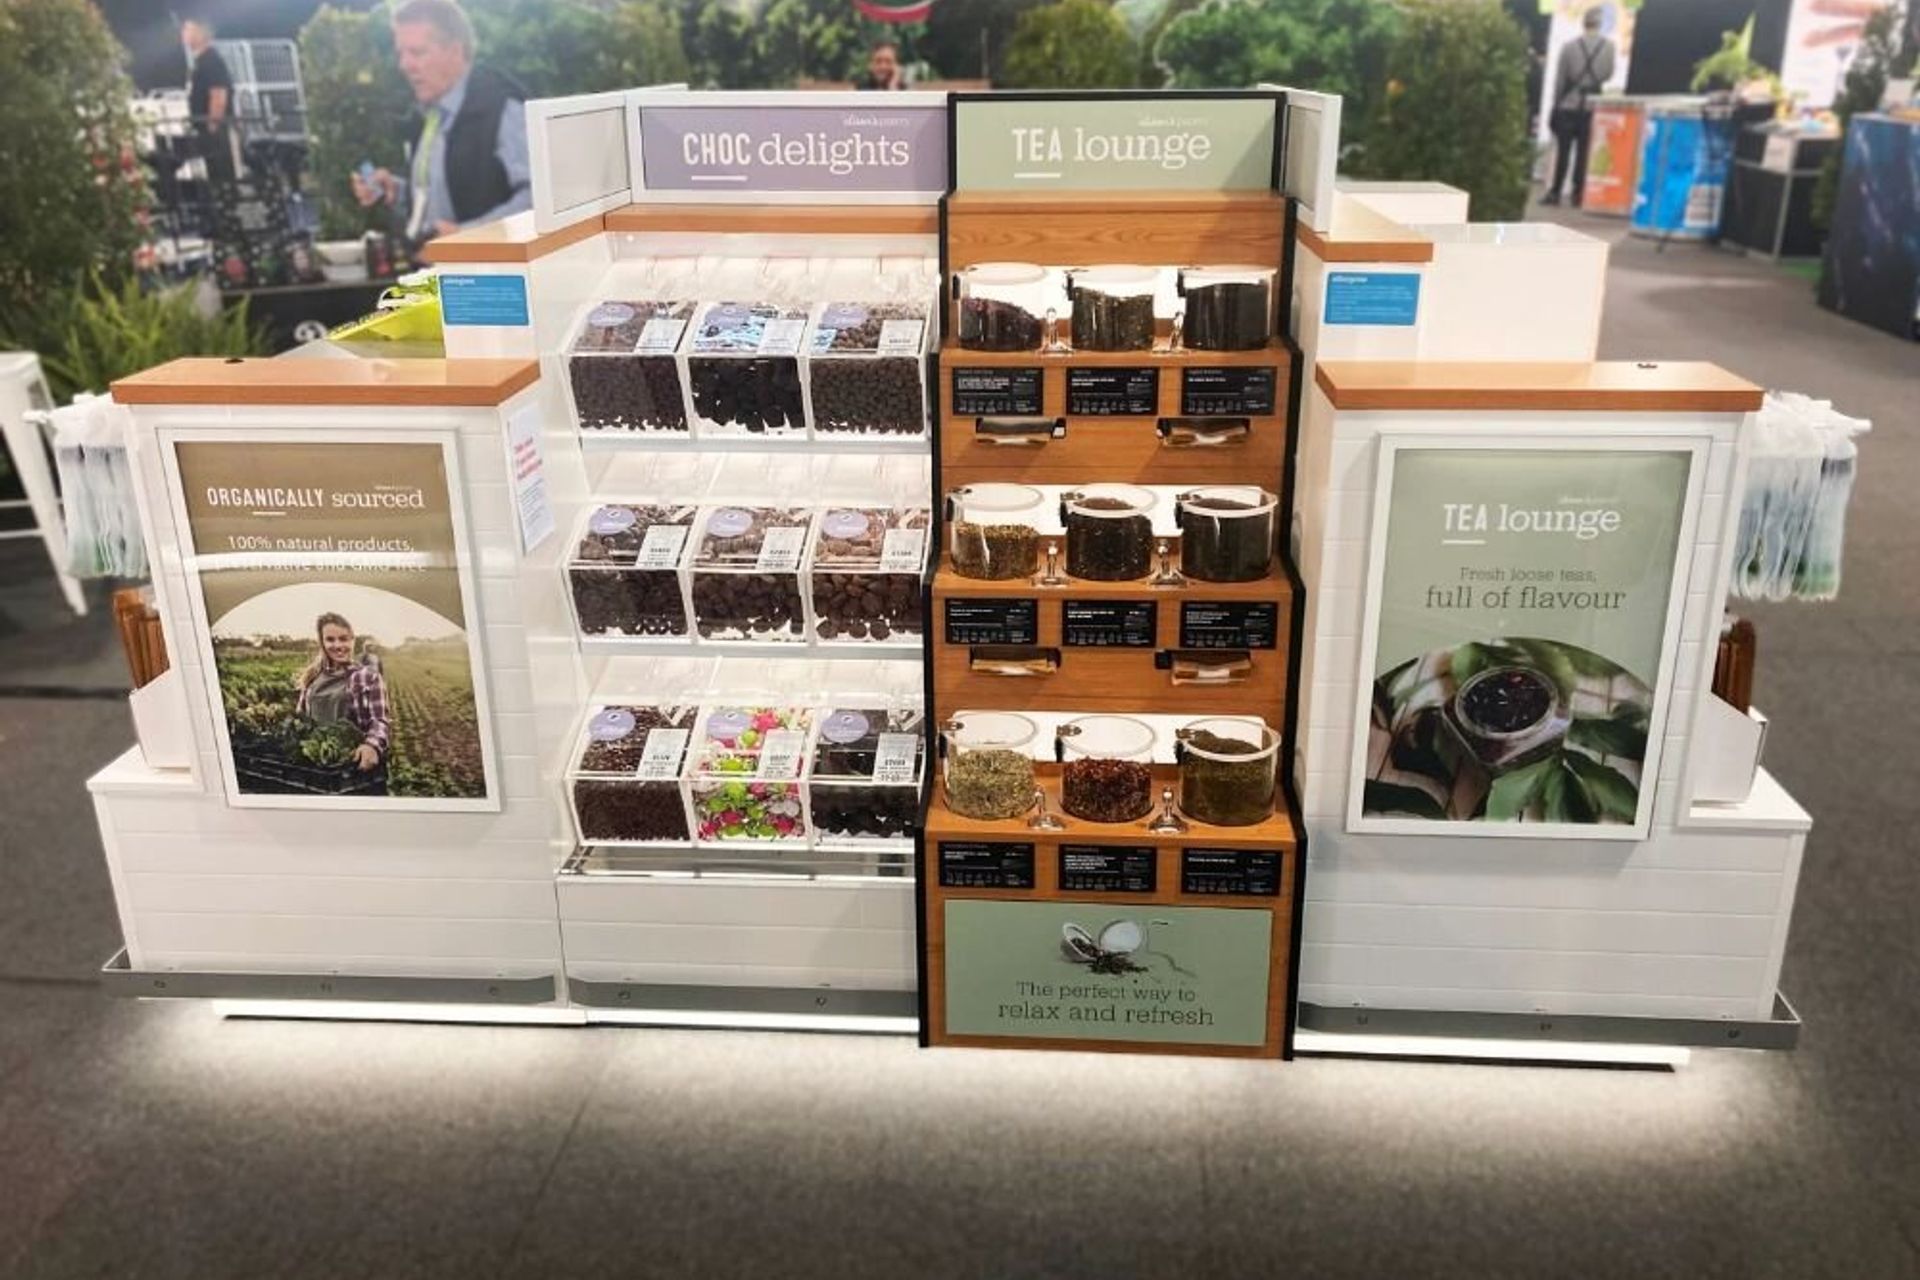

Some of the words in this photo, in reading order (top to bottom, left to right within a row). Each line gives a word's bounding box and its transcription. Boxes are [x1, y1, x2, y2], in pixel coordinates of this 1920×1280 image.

[683, 132, 751, 166] CHOC
[757, 132, 910, 174] delights
[1011, 127, 1063, 162] TEA
[1073, 127, 1211, 169] lounge
[207, 487, 323, 507] ORGANICALLY
[331, 489, 426, 508] sourced
[1443, 503, 1488, 531] TEA
[1496, 503, 1622, 539] lounge
[228, 535, 272, 550] 100%
[276, 535, 332, 551] natural
[337, 536, 415, 554] products,
[1460, 567, 1505, 582] Fresh
[1510, 567, 1554, 582] loose
[1560, 567, 1598, 584] teas,
[1425, 585, 1473, 609] full
[1482, 585, 1512, 609] of
[1520, 585, 1627, 609] flavour
[1016, 980, 1054, 997] The
[1059, 982, 1127, 1000] perfect
[1132, 986, 1171, 1003] way
[1178, 985, 1197, 1002] to
[998, 1000, 1061, 1020] relax
[1068, 1003, 1116, 1022] and
[1125, 1006, 1214, 1026] refresh
